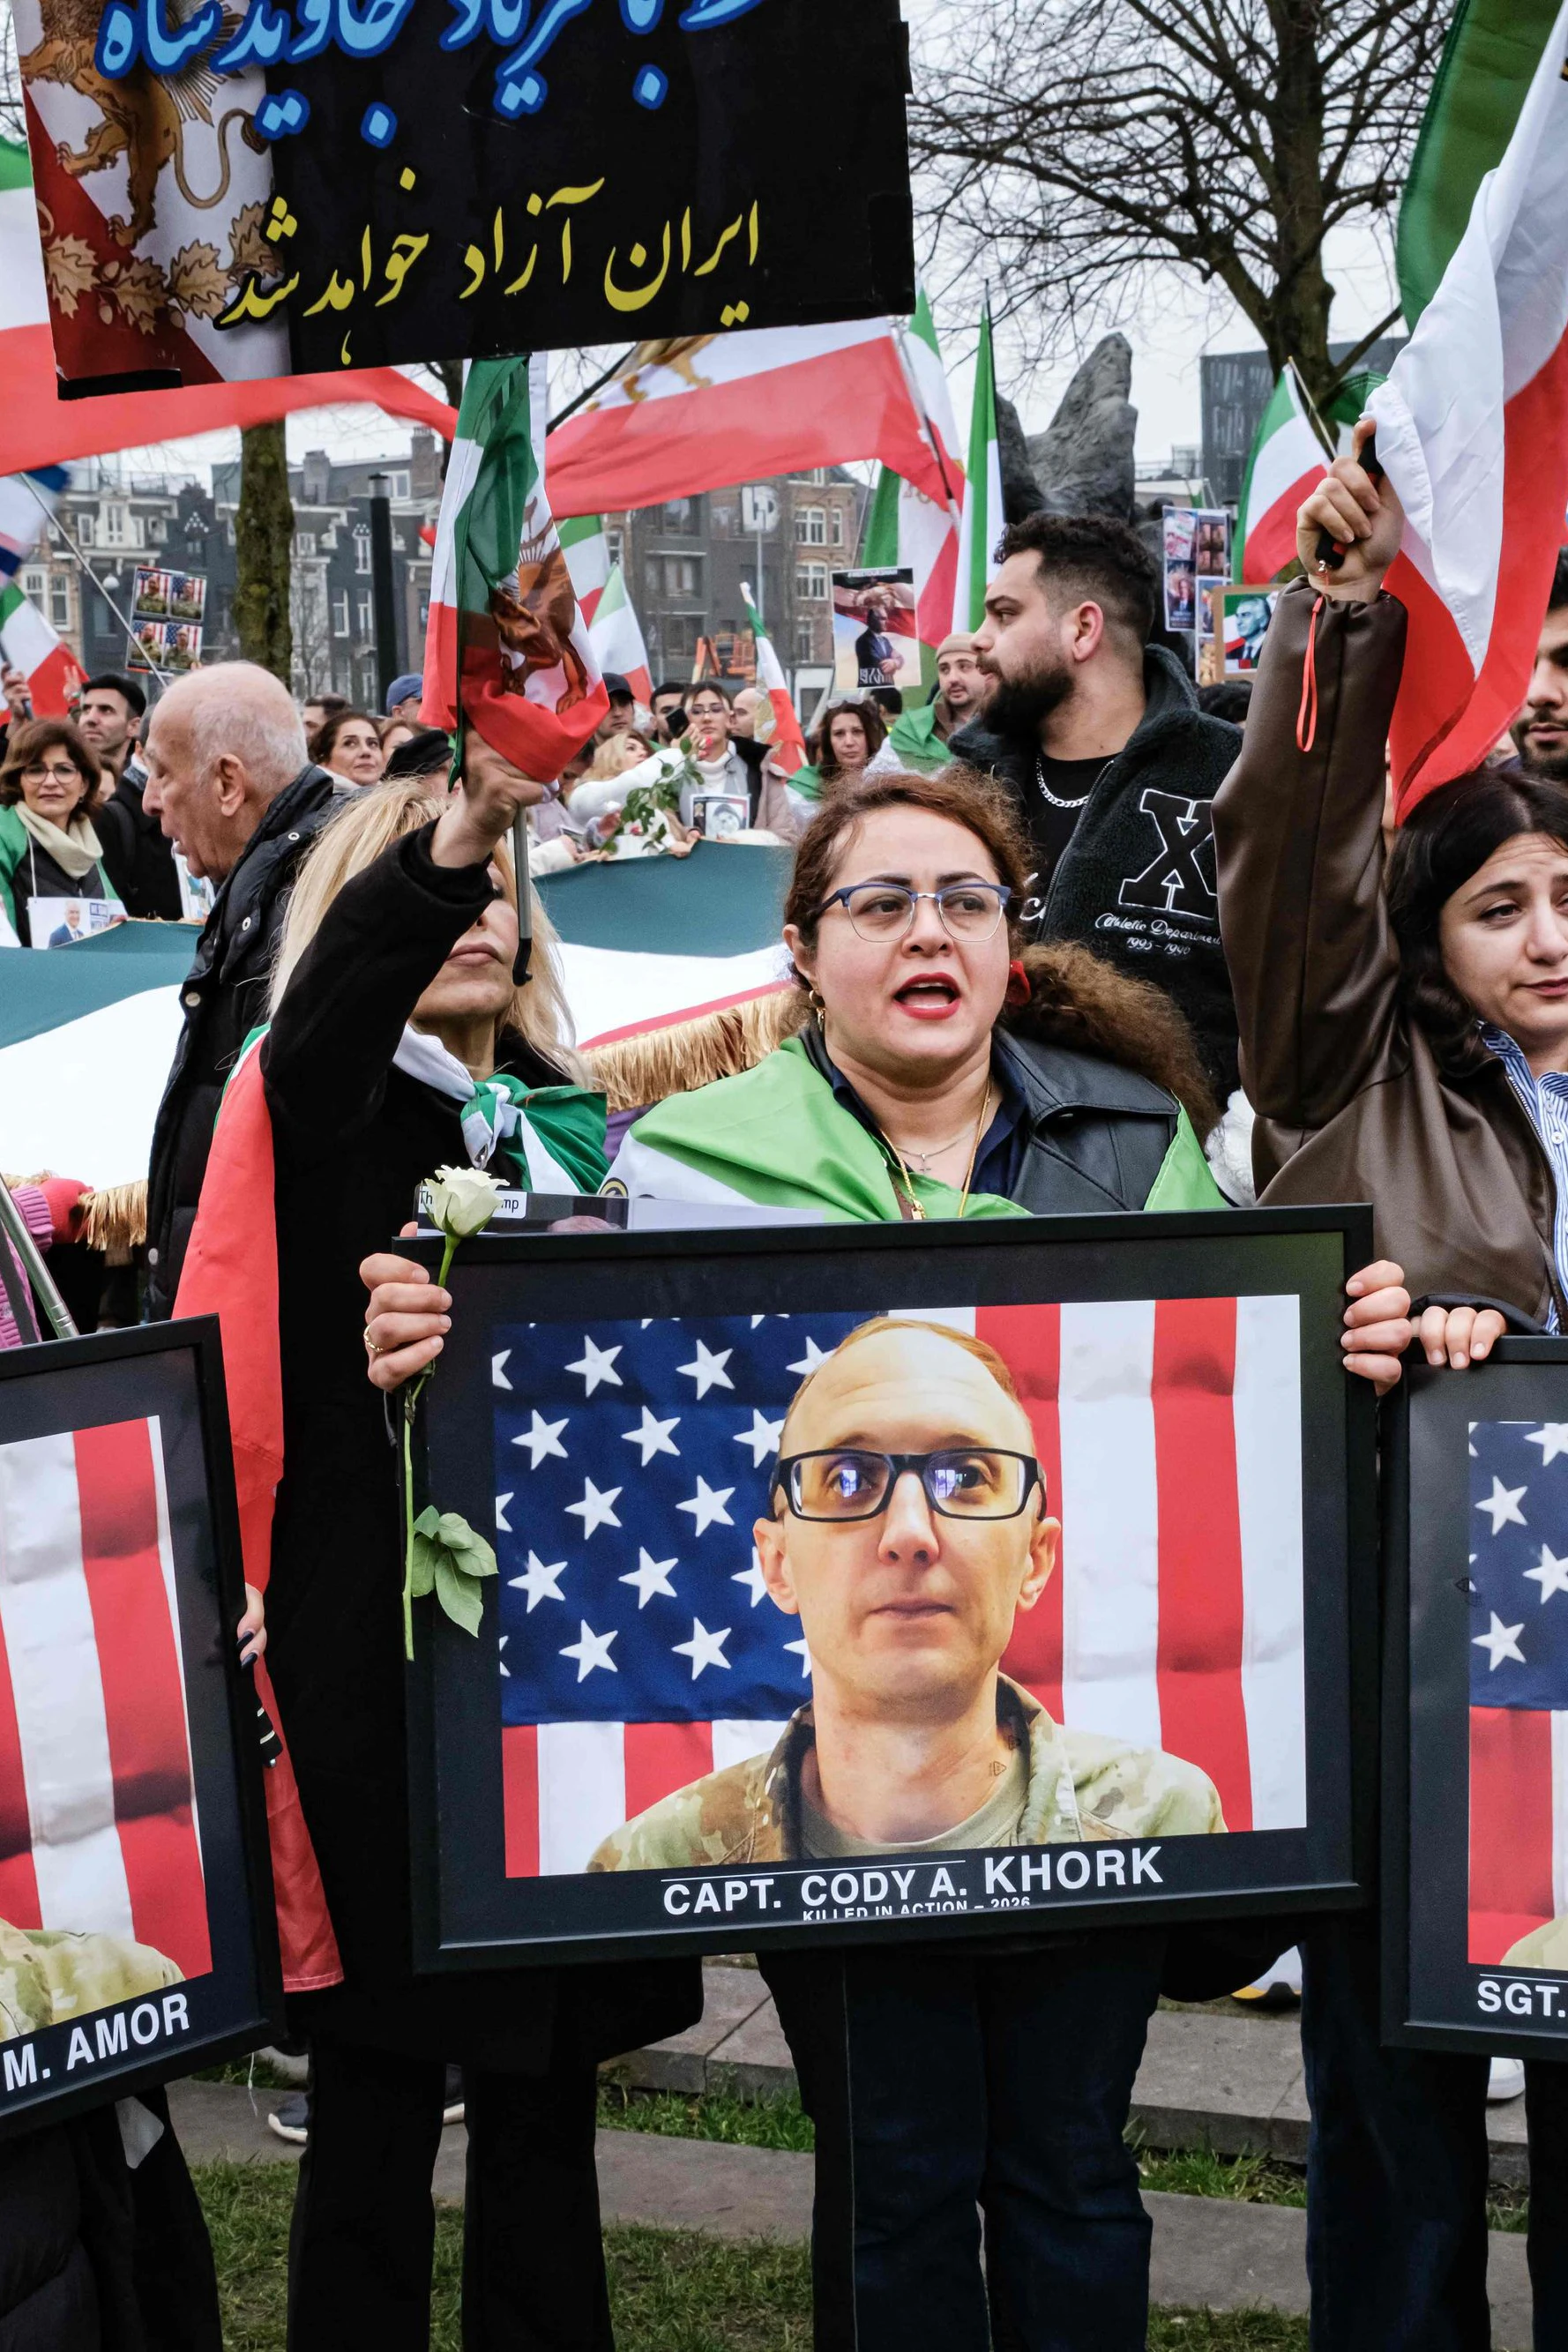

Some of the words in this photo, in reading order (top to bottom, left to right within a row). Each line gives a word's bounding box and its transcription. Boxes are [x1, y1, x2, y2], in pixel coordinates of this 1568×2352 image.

[220, 195, 300, 325] شد
[458, 176, 605, 299] آزاد
[604, 199, 758, 327] ایران
[663, 1878, 781, 1915] CAPT.
[800, 1869, 916, 1907] CODY
[929, 1867, 967, 1898] A.
[984, 1846, 1163, 1894] KHORK
[875, 1905, 892, 1916] IN
[2, 2042, 52, 2092] M.
[66, 1992, 190, 2071] AMOR
[1477, 1980, 1566, 2018] SGT.
